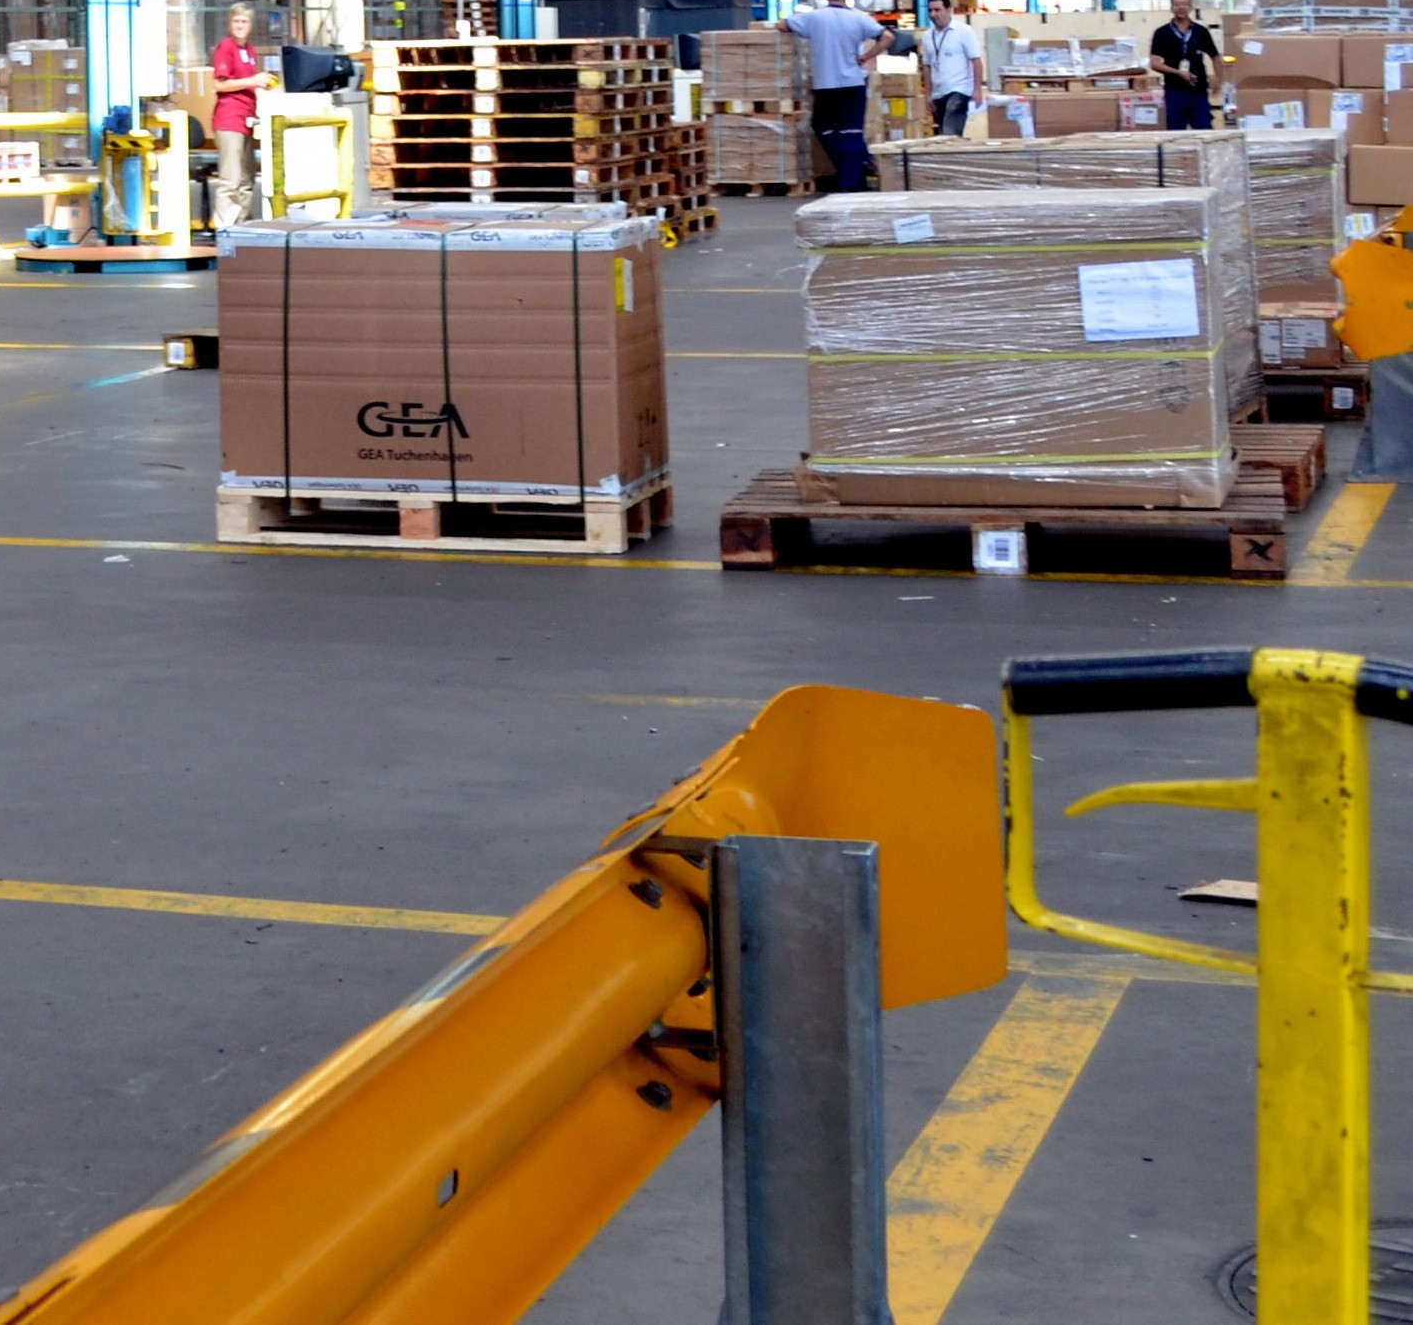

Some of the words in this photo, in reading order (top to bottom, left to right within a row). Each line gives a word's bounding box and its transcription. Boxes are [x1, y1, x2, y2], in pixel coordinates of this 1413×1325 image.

[357, 401, 470, 438] GEA
[358, 448, 385, 460] GEA
[387, 448, 473, 462] Tuchenhaen
